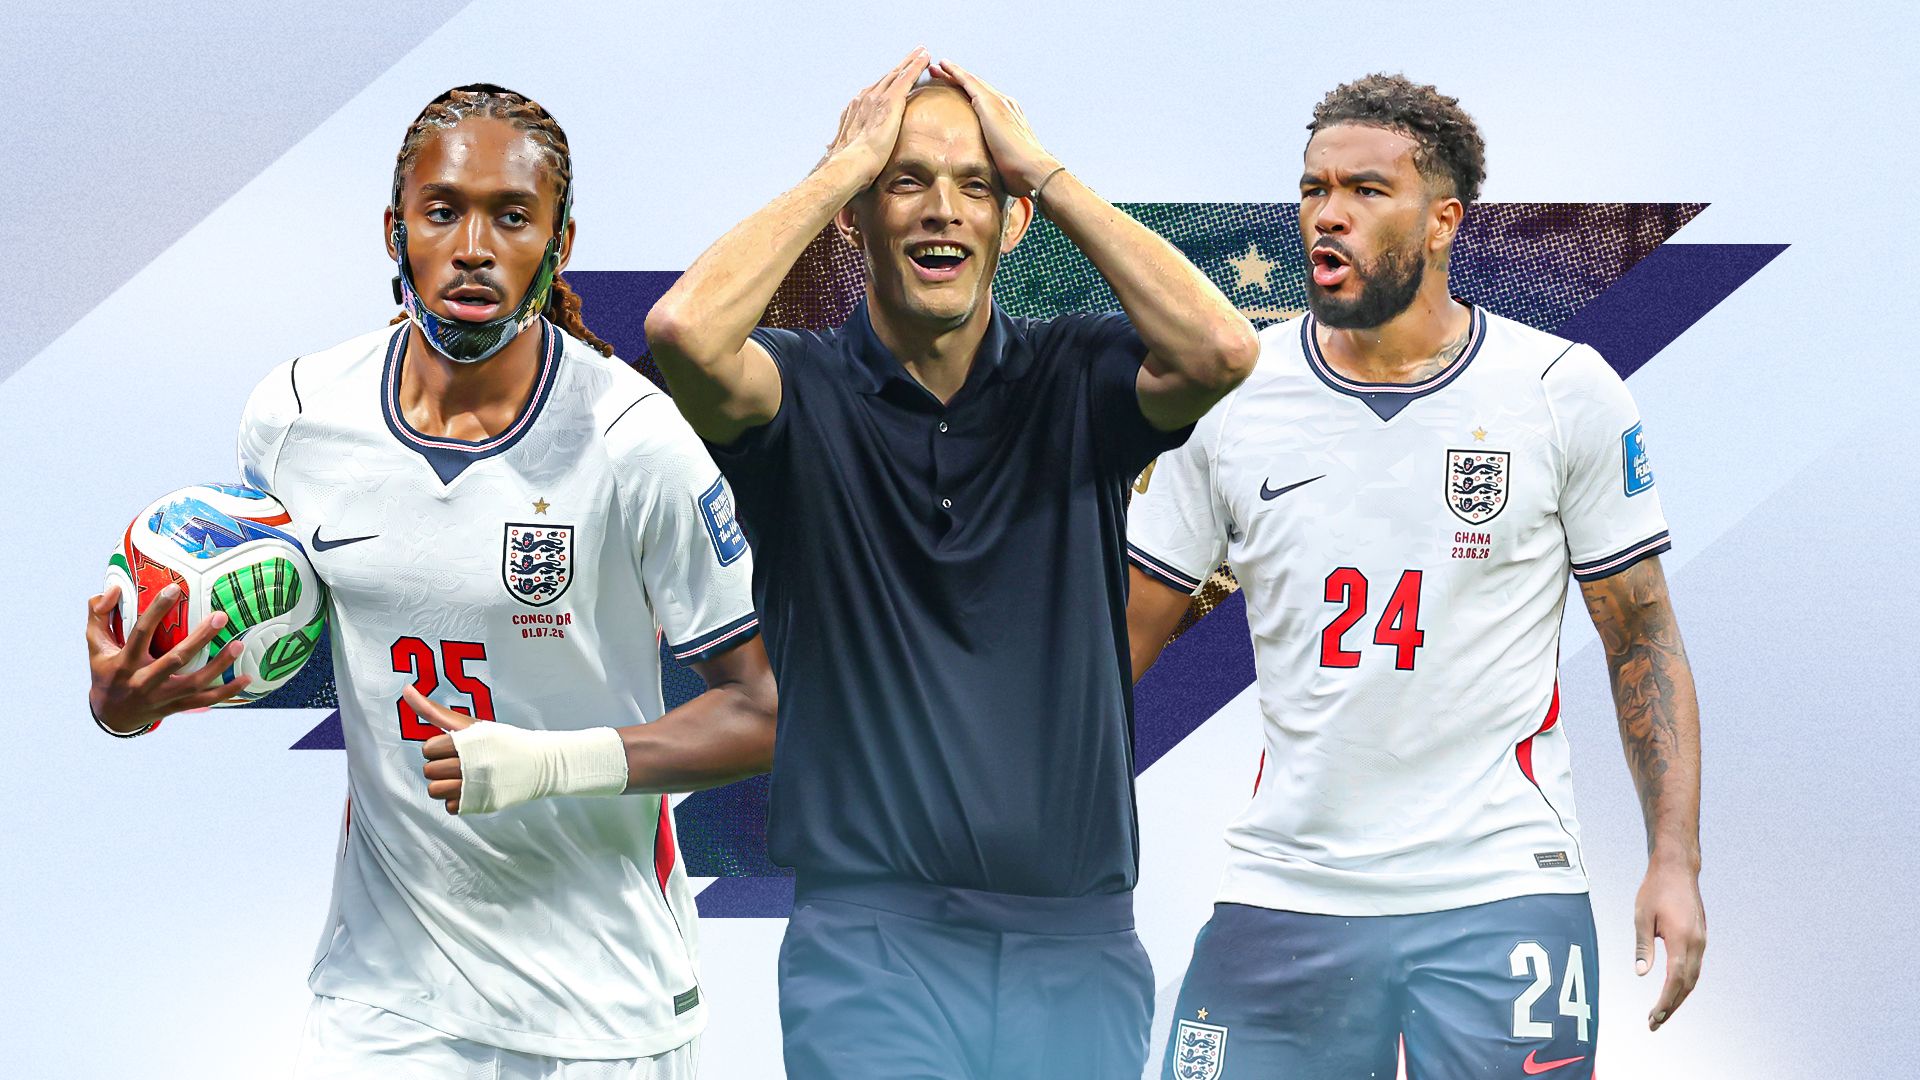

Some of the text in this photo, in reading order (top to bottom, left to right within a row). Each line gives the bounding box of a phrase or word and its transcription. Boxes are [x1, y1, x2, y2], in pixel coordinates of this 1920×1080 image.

[1454, 531, 1491, 545] GHANA
[1451, 547, 1490, 559] 23.06.26
[512, 612, 572, 625] CONGO DR
[1319, 566, 1425, 671] 24
[521, 627, 565, 639] 01.07.26
[390, 635, 497, 742] 25
[1507, 940, 1592, 1043] 24
